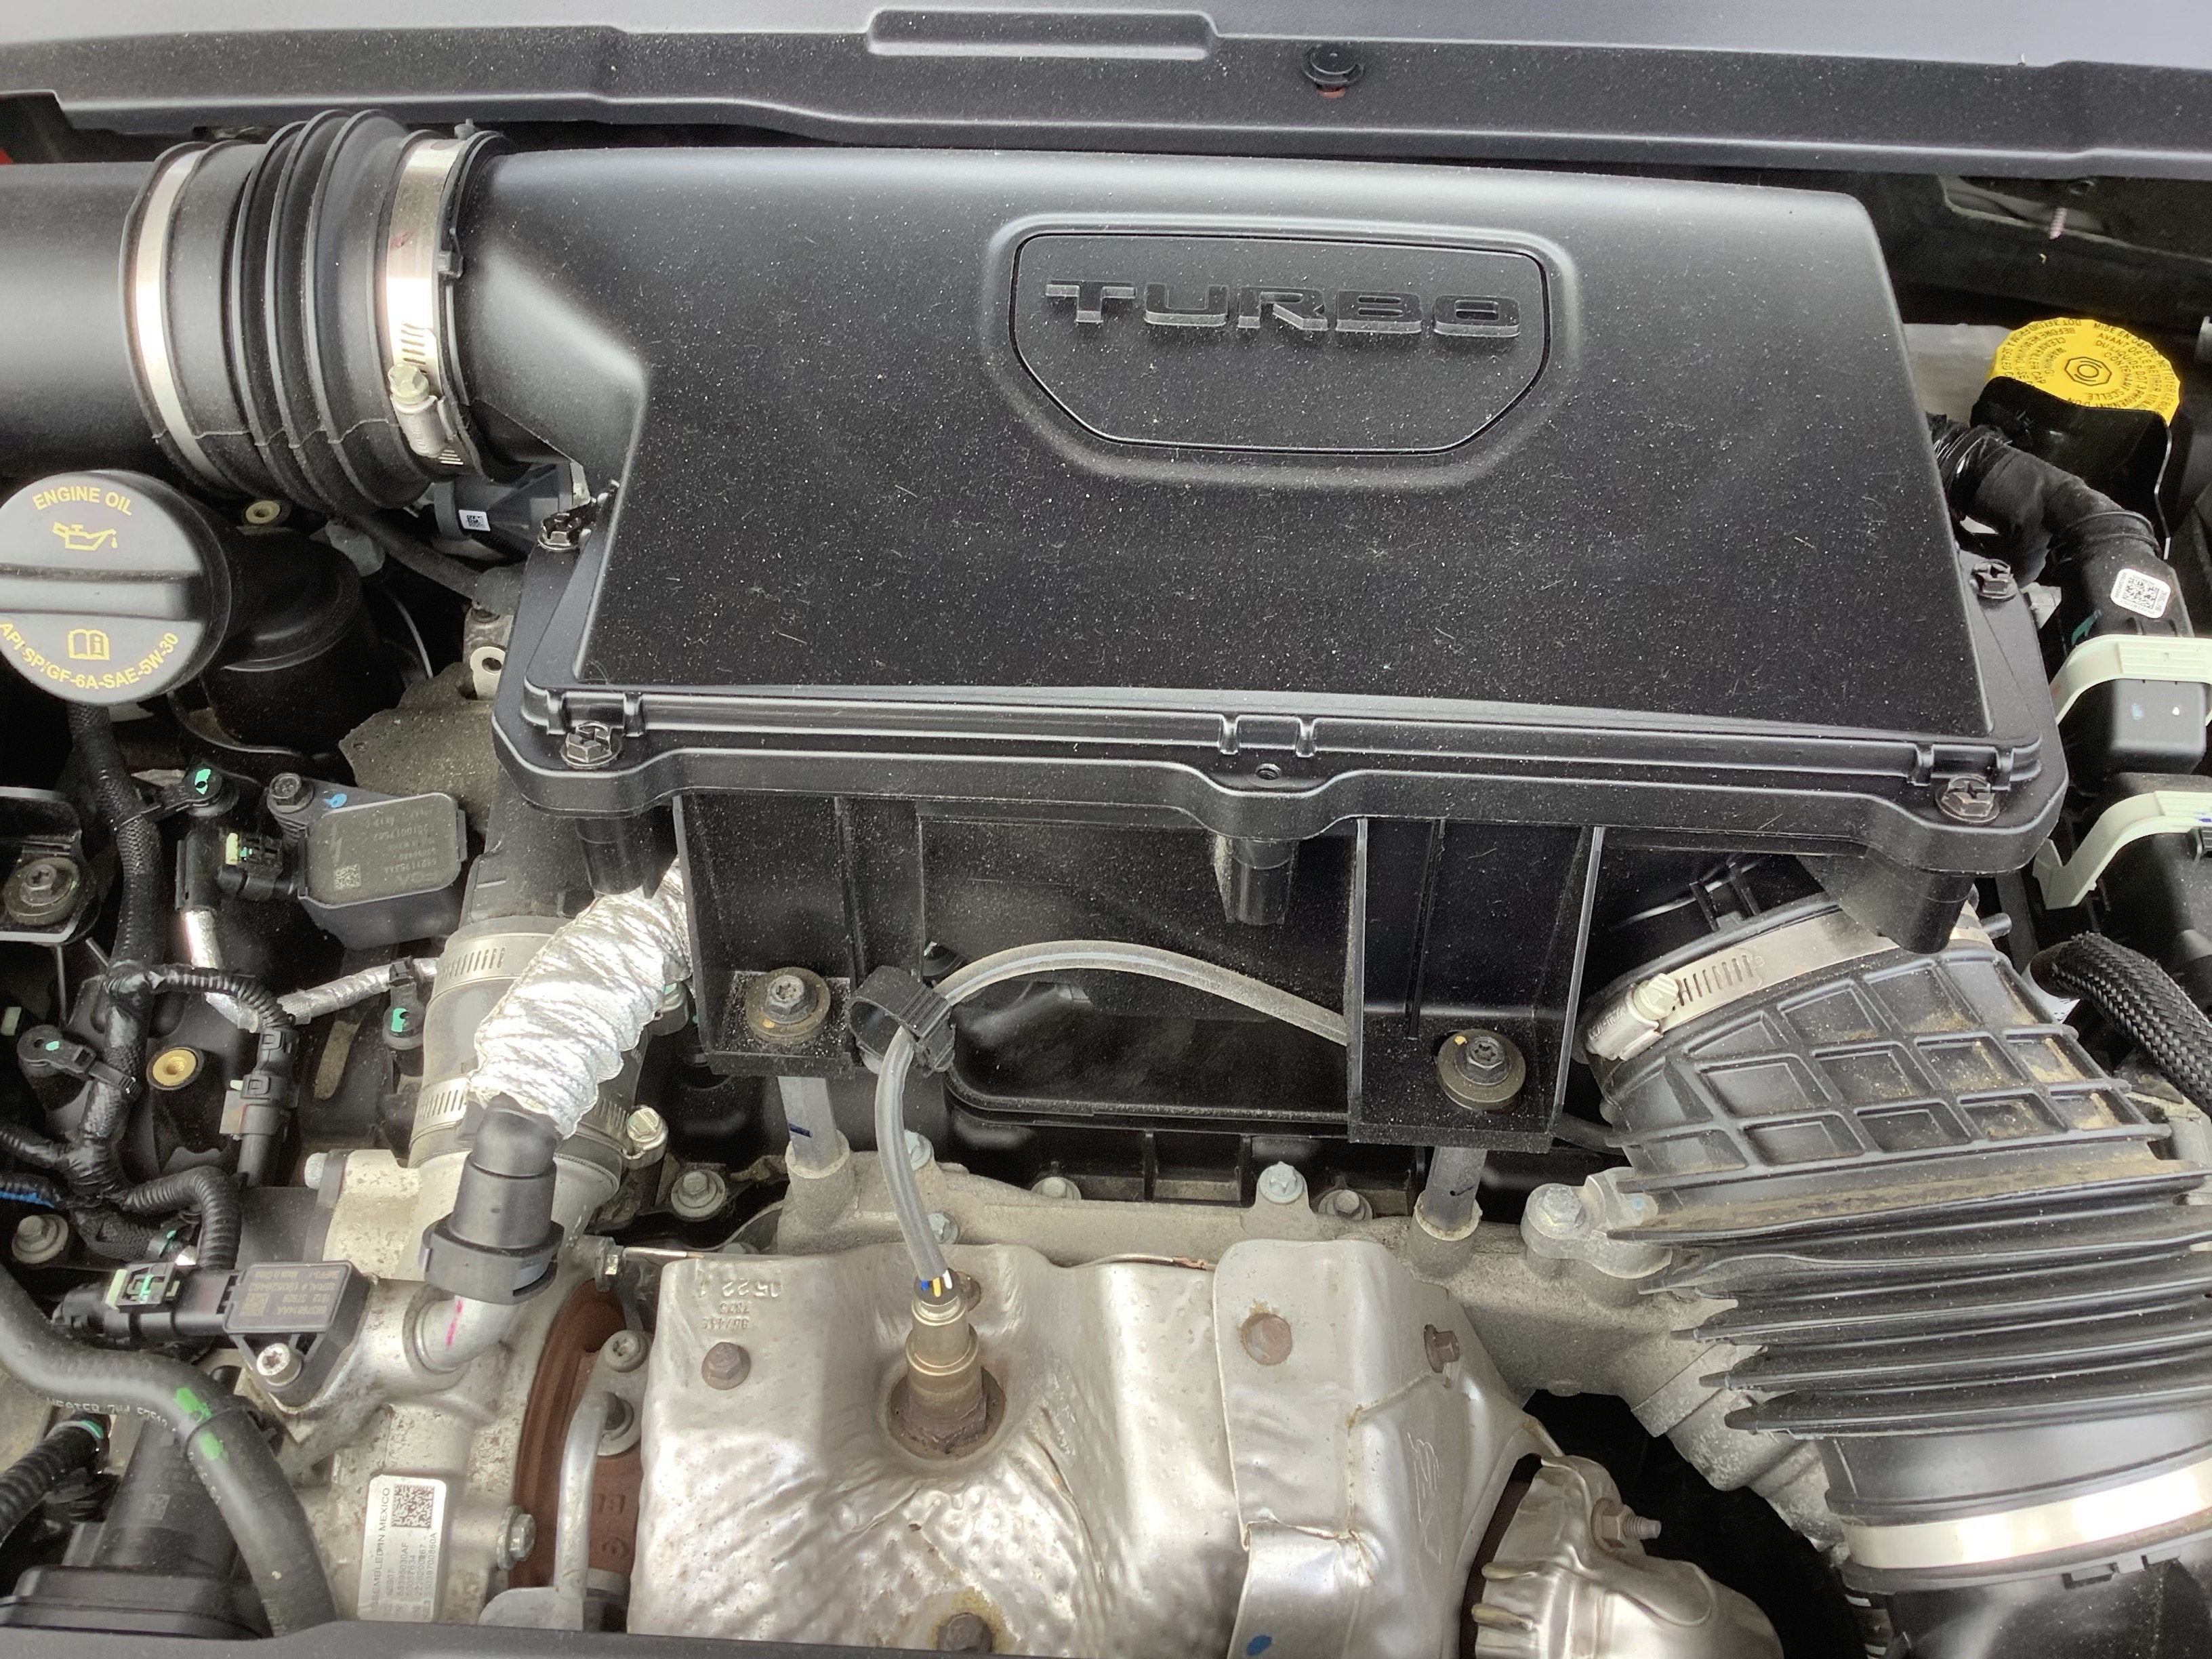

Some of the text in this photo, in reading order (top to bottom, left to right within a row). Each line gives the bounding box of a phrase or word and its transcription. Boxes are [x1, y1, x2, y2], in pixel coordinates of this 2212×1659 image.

[1045, 279, 1521, 337] TURBO
[2009, 327, 2032, 343] FROM
[2036, 327, 2076, 338] BEFORE
[2093, 321, 2117, 333] MISE
[2117, 330, 2133, 340] EN
[1999, 345, 2015, 370] SEALED
[2029, 347, 2045, 369] FILLER
[2097, 331, 2130, 348] AVANT
[2127, 346, 2144, 356] DE
[2137, 355, 2153, 364] LE
[2013, 366, 2030, 379] USE
[2095, 339, 2110, 349] DU
[2109, 345, 2143, 369] LIQUIDE
[2134, 371, 2148, 385] DOT
[2102, 350, 2134, 392] CONTENANT
[2029, 371, 2049, 385] CAP
[32, 486, 134, 516] ENGINE OIL
[0, 623, 24, 651] API
[371, 1548, 384, 1615] ASSEMBLED
[380, 1488, 390, 1530] MEXICO
